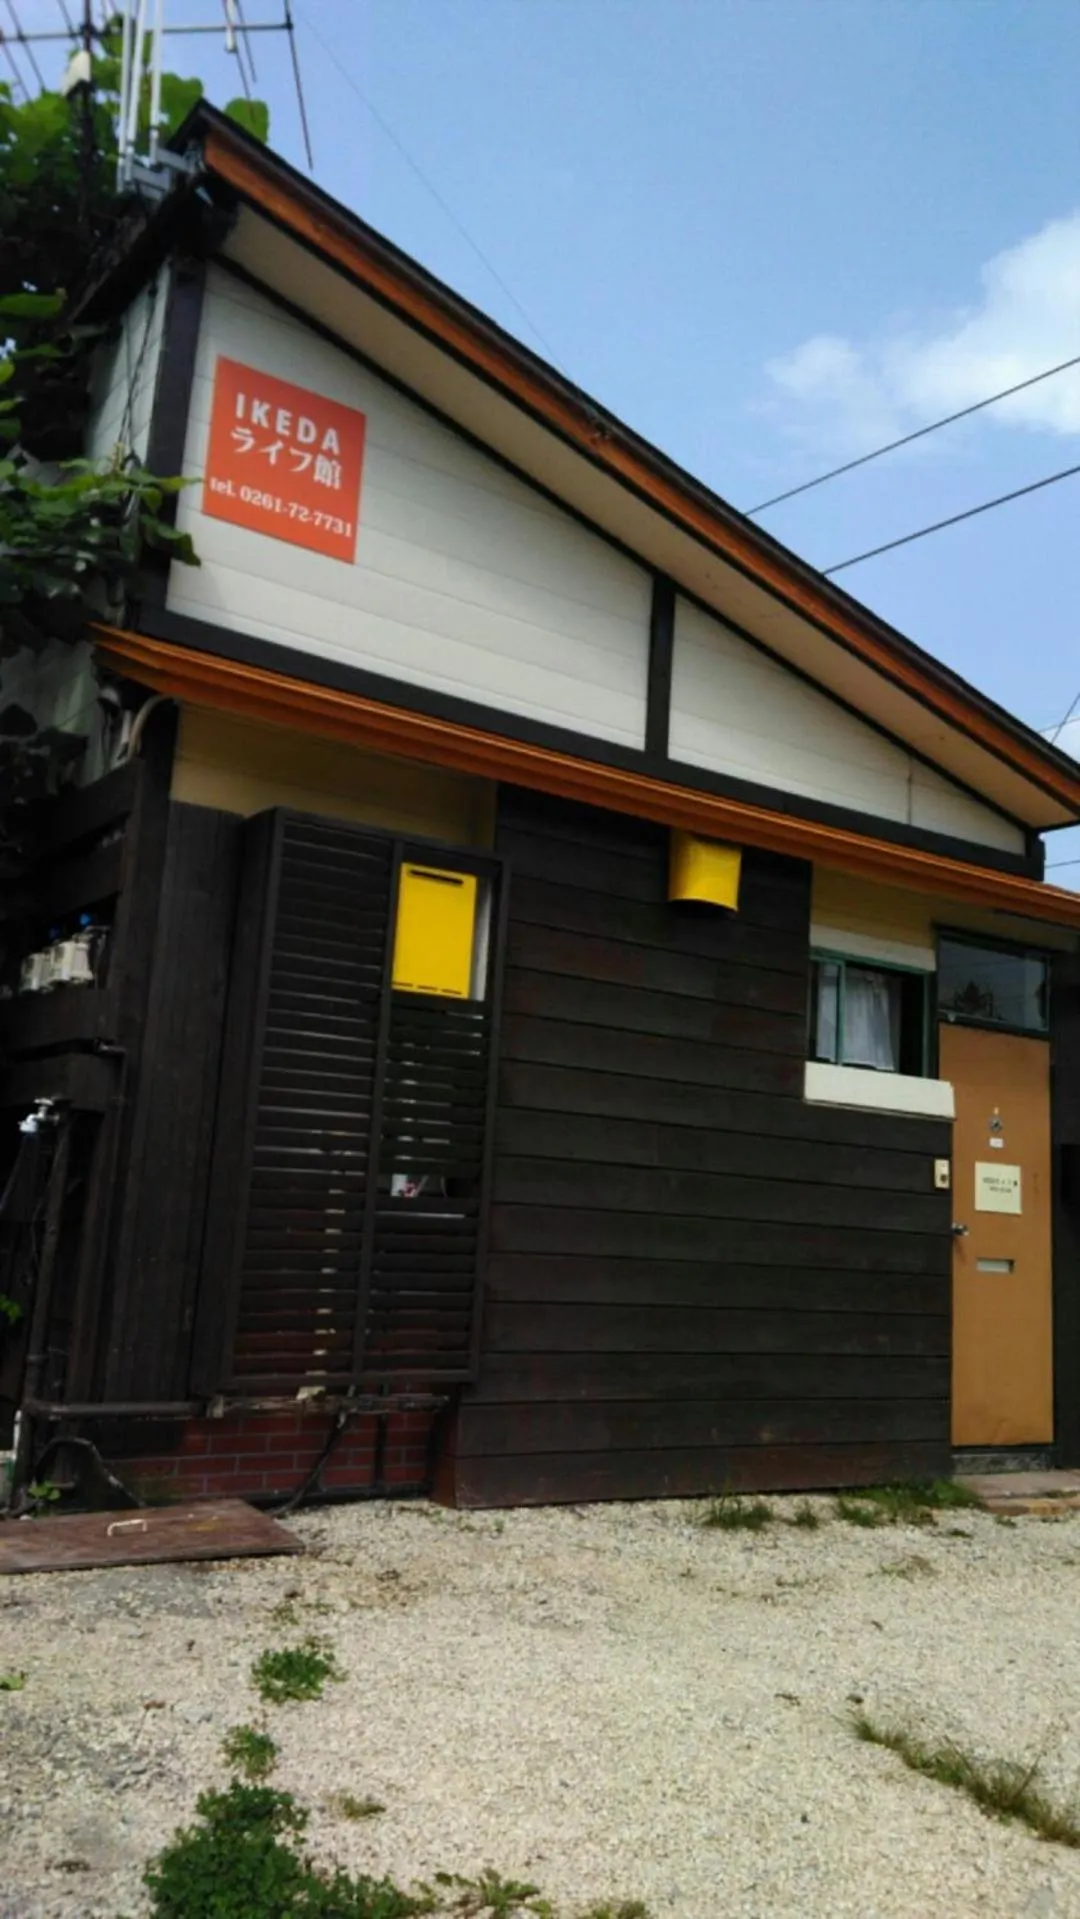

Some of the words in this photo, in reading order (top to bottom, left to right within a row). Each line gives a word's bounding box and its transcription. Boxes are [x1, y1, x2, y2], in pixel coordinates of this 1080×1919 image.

[235, 393, 341, 455] IKEDA
[230, 426, 342, 490] ライフ館
[210, 477, 236, 498] tel.
[240, 486, 352, 537] 0261-72-7731
